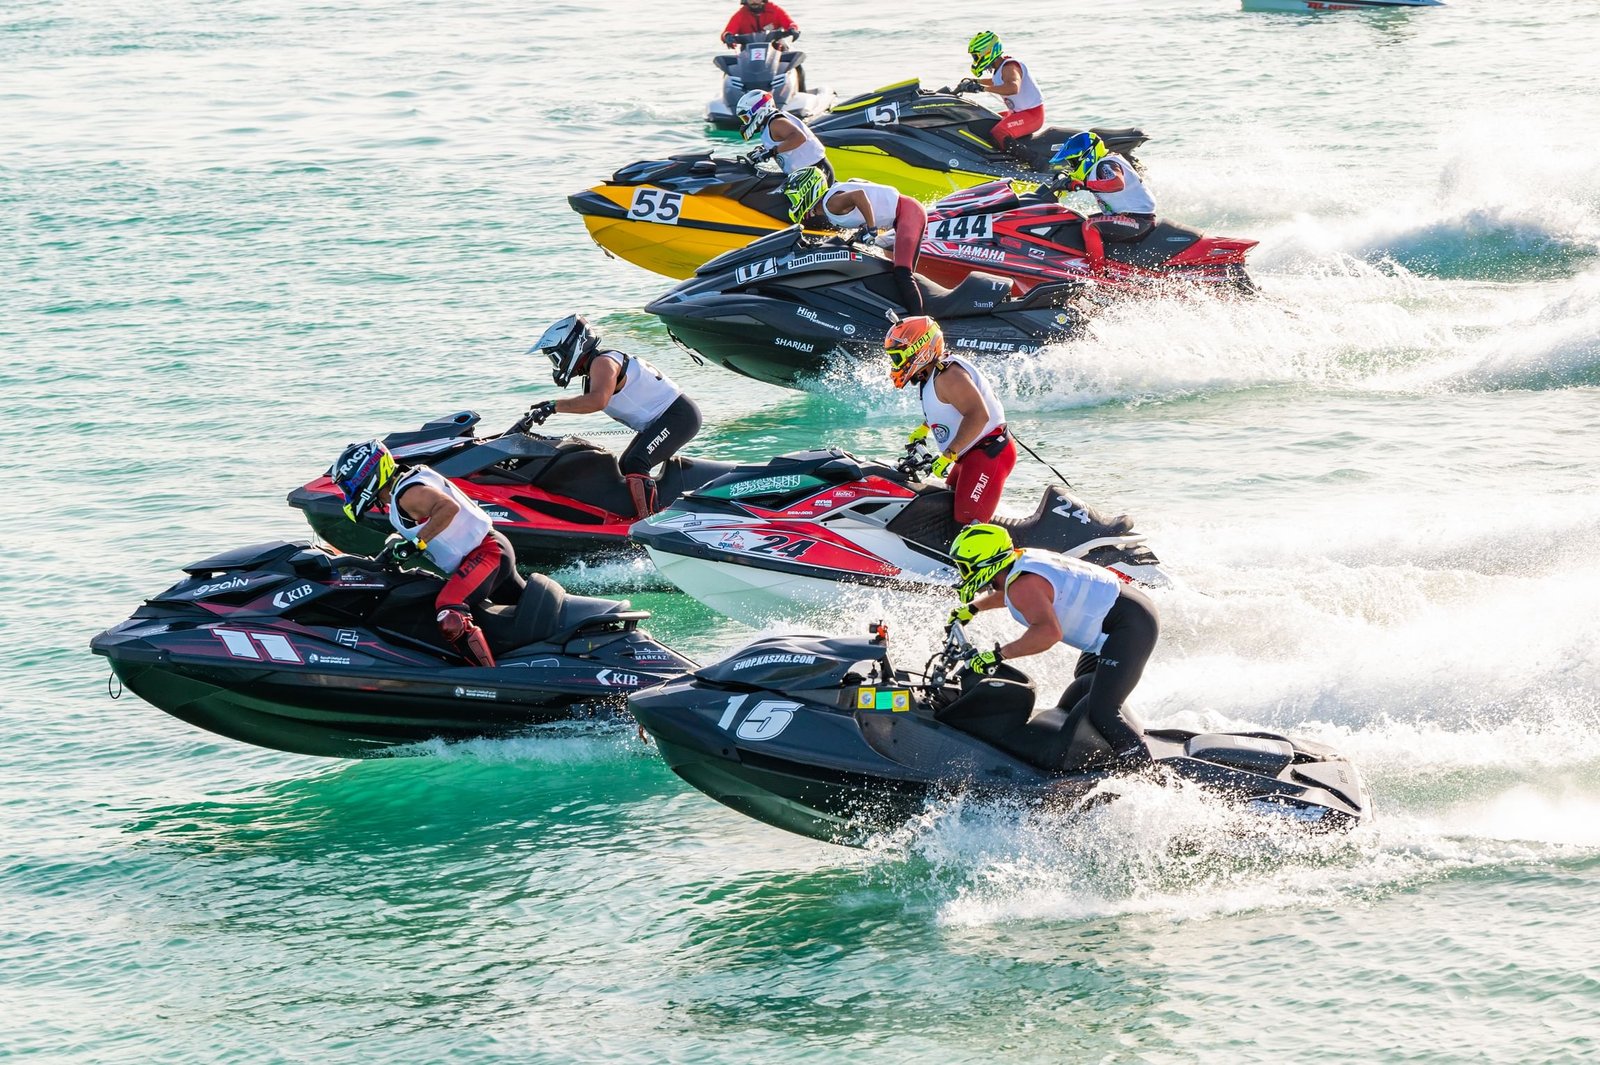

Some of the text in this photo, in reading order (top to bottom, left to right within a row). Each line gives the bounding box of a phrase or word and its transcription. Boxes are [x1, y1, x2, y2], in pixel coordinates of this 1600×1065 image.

[875, 104, 897, 124] 5
[632, 189, 682, 221] 55
[935, 213, 987, 240] 444
[957, 244, 1006, 262] YAMAHA
[991, 281, 1005, 291] 17
[797, 306, 818, 319] High
[774, 337, 815, 353] SHARJAH
[910, 332, 931, 355] JTPLT
[646, 427, 671, 455] JETPILOT
[970, 472, 990, 503] JETPILOT
[1052, 495, 1091, 525] 24
[749, 535, 818, 559] 24
[285, 584, 313, 602] KIB
[211, 628, 303, 664] 11
[732, 655, 817, 671] SHOP.KASZA5.COM
[612, 672, 639, 686] KIB
[717, 693, 805, 741] 15
